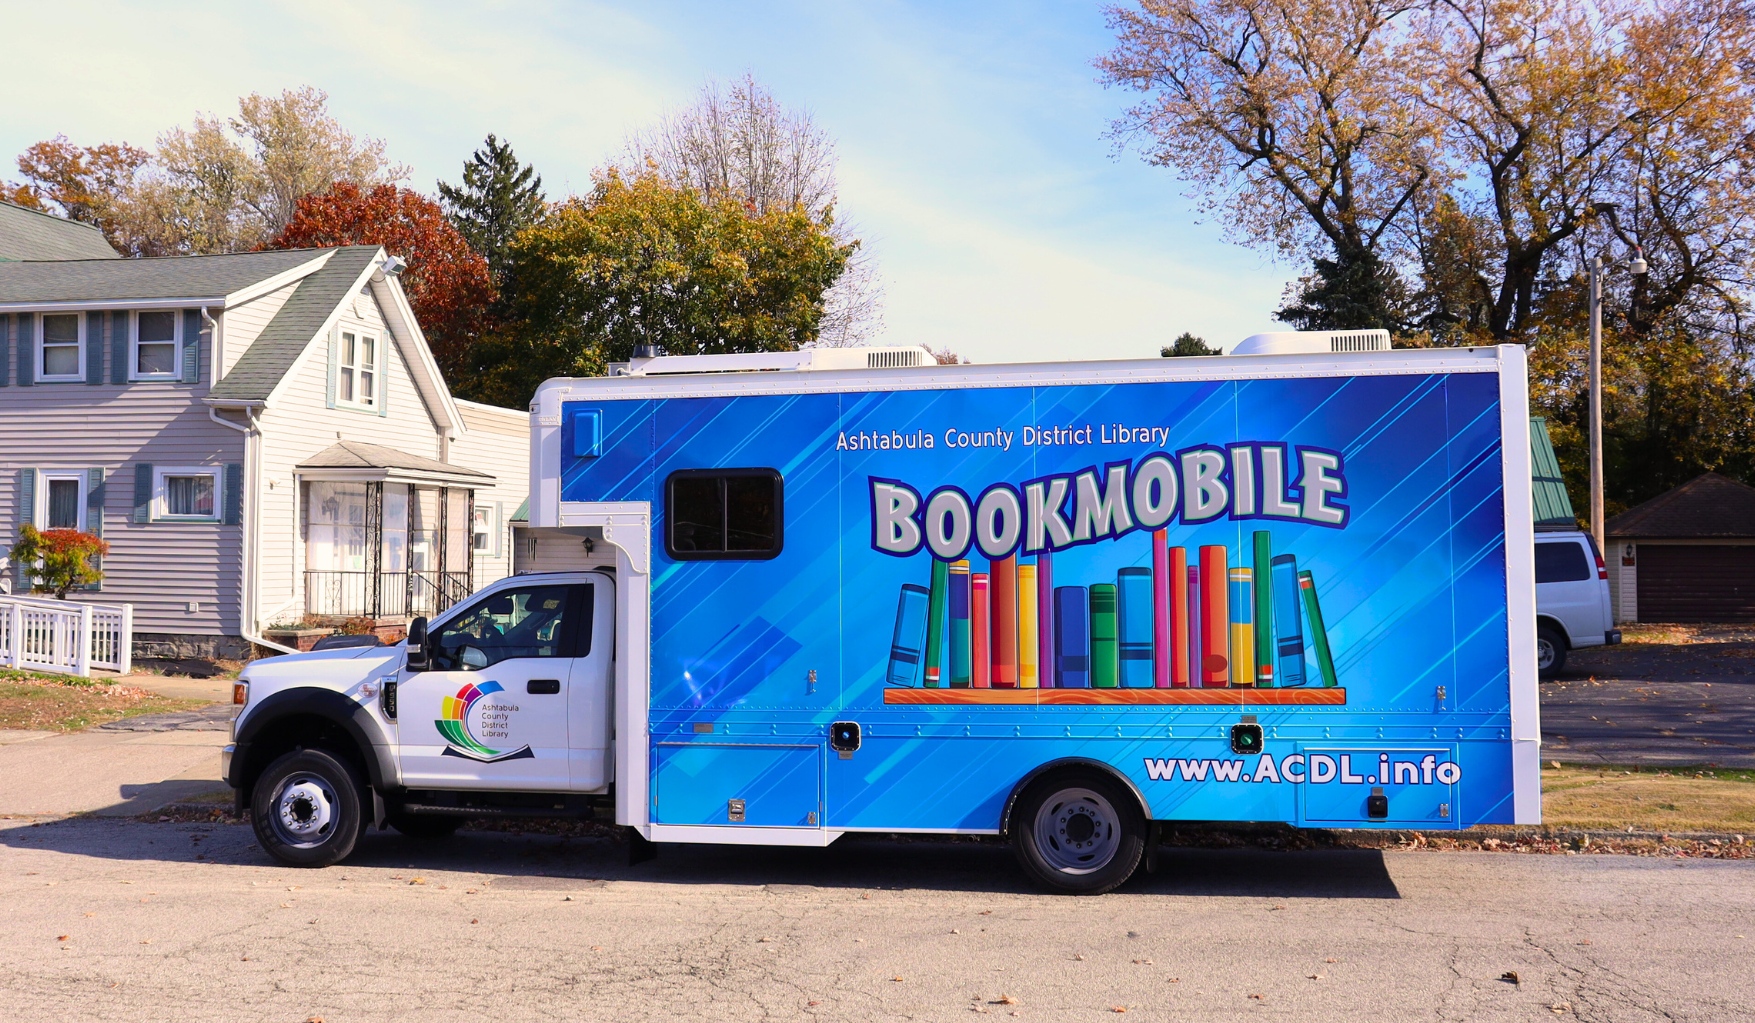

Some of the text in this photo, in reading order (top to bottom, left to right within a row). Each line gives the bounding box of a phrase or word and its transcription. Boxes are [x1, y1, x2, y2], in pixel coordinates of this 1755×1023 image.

[836, 424, 1170, 451] Ashtabula County District Library
[869, 442, 1350, 558] BOOKMOBILE
[481, 703, 519, 712] Ashtabula
[481, 712, 509, 721] County
[481, 721, 508, 729] District
[481, 730, 509, 739] Library
[1144, 753, 1463, 786] www.ACDL.info
